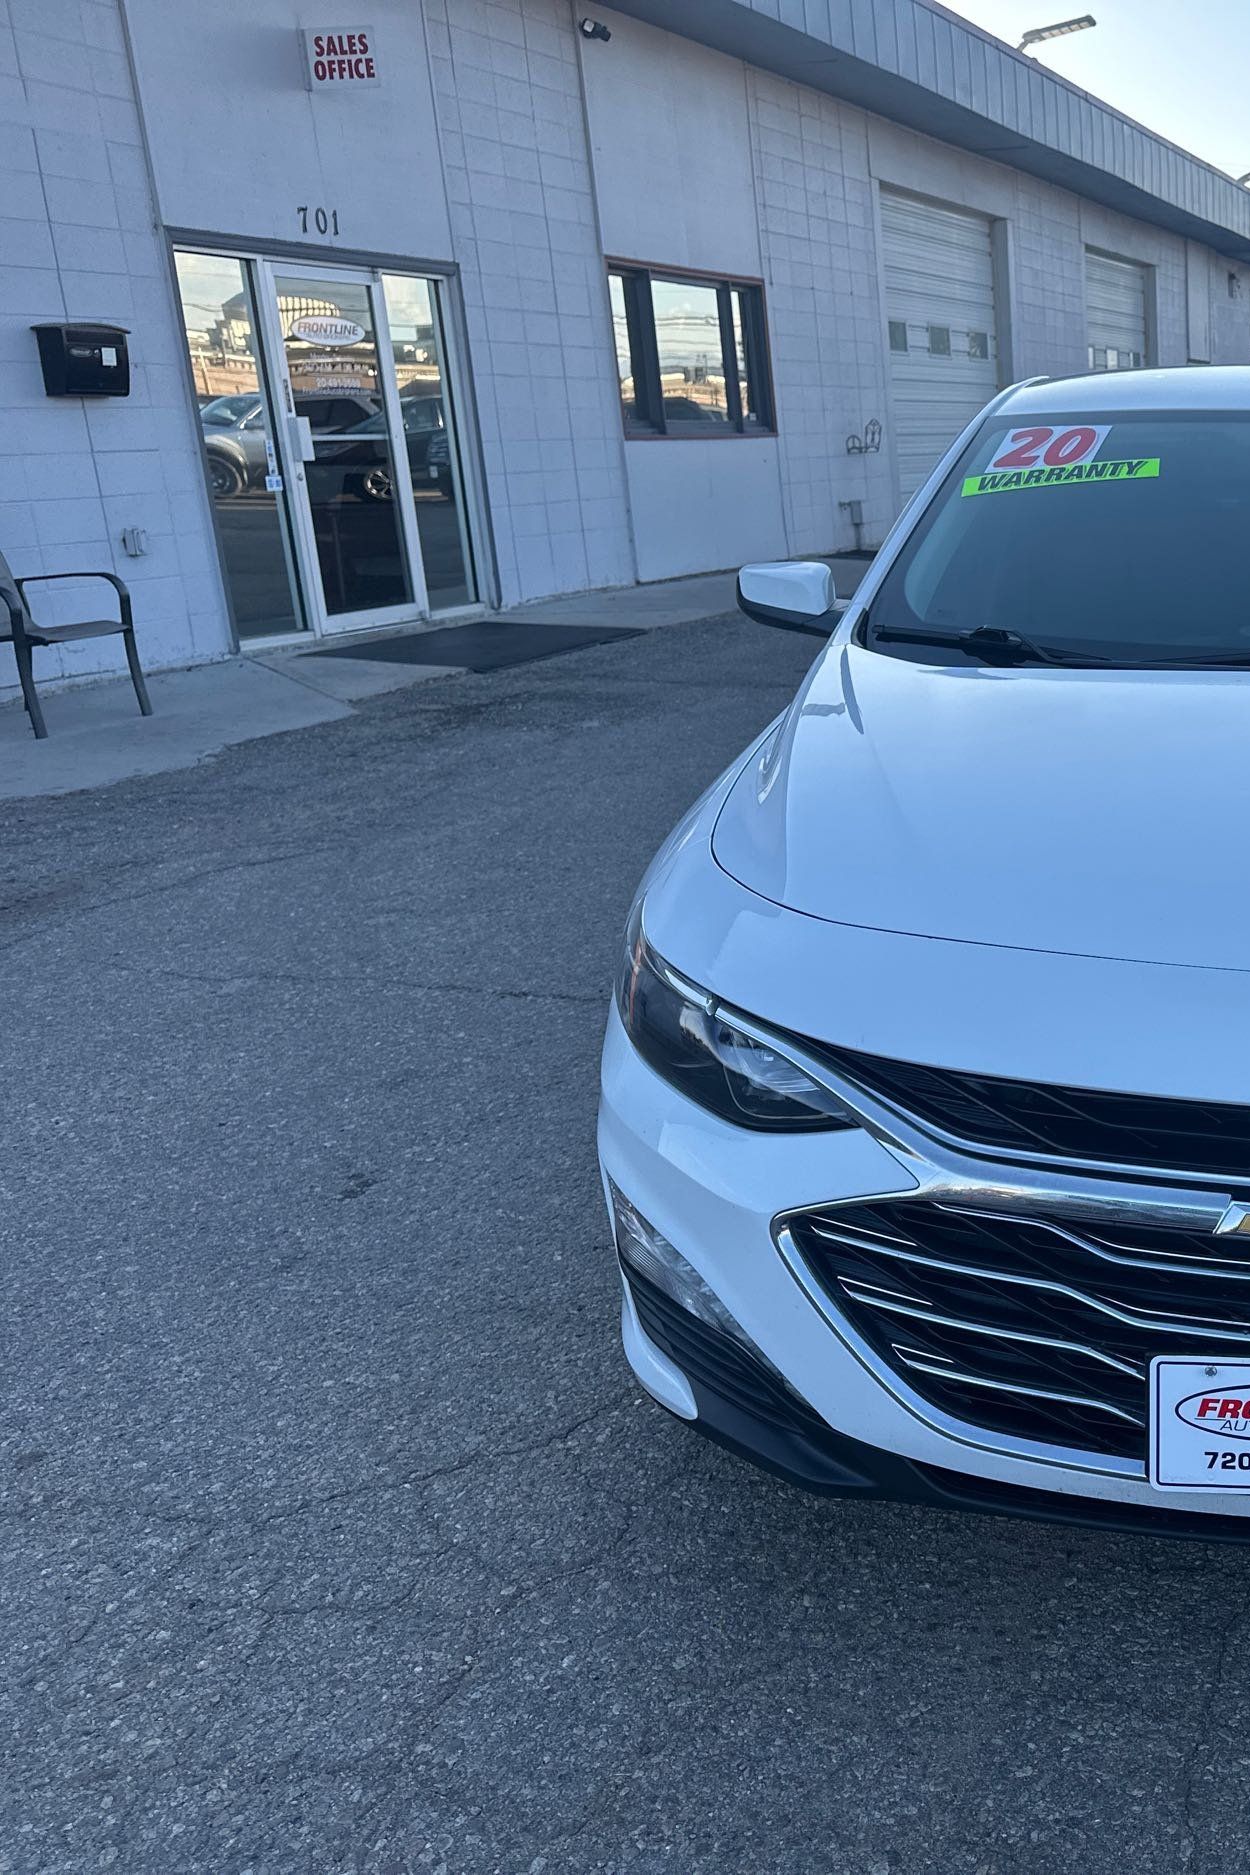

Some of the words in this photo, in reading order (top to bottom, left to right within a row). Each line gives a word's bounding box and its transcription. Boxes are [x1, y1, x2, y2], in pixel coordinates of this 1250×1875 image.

[314, 33, 369, 57] SALES
[314, 57, 375, 81] OFFICE
[297, 205, 339, 236] 701
[297, 321, 359, 337] FRONTLINE
[993, 427, 1097, 469] 20
[977, 460, 1149, 491] WARRANTY
